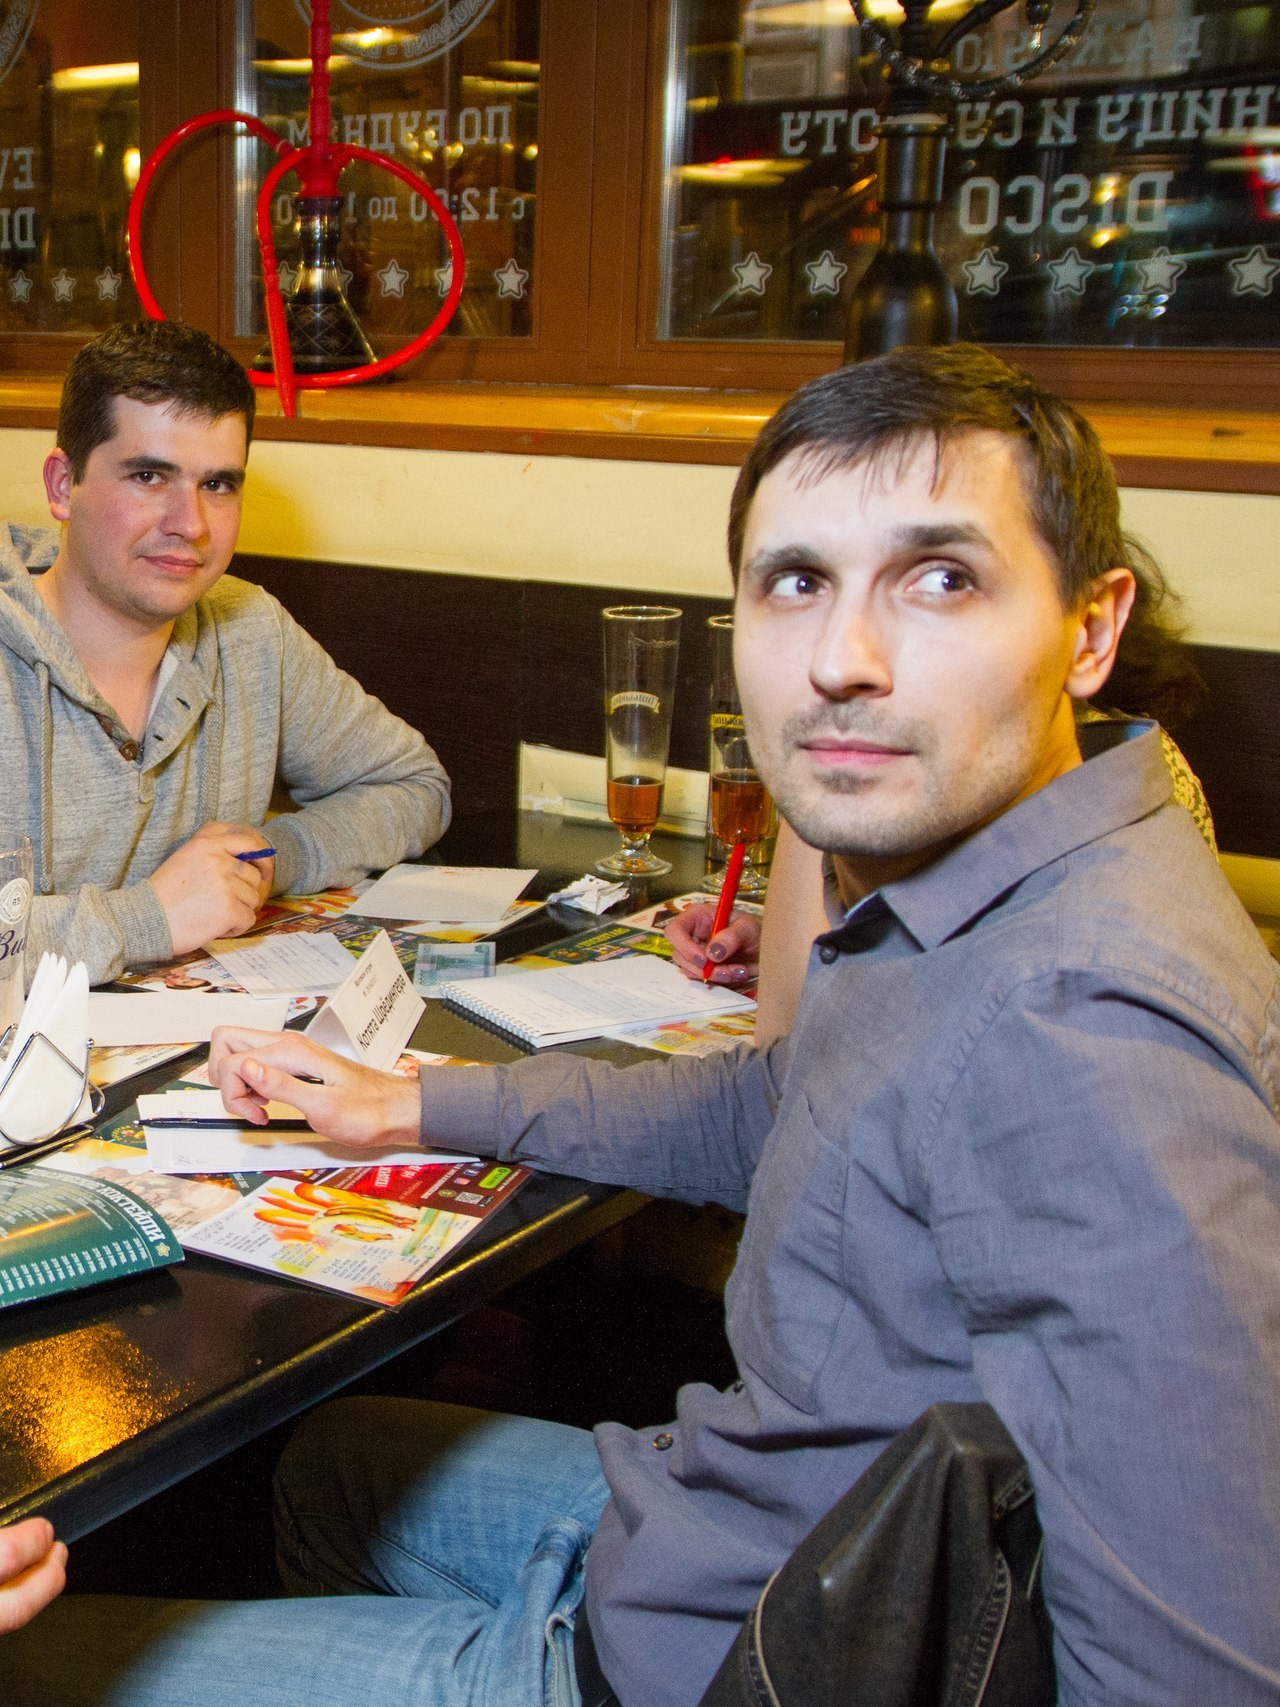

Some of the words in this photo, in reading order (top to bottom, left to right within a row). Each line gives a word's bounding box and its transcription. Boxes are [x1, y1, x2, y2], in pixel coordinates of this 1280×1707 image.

[356, 1018, 380, 1052] Котята
[372, 973, 407, 1026] Шрёдингера
[98, 1183, 166, 1243] КОКТЕЙЛИ
